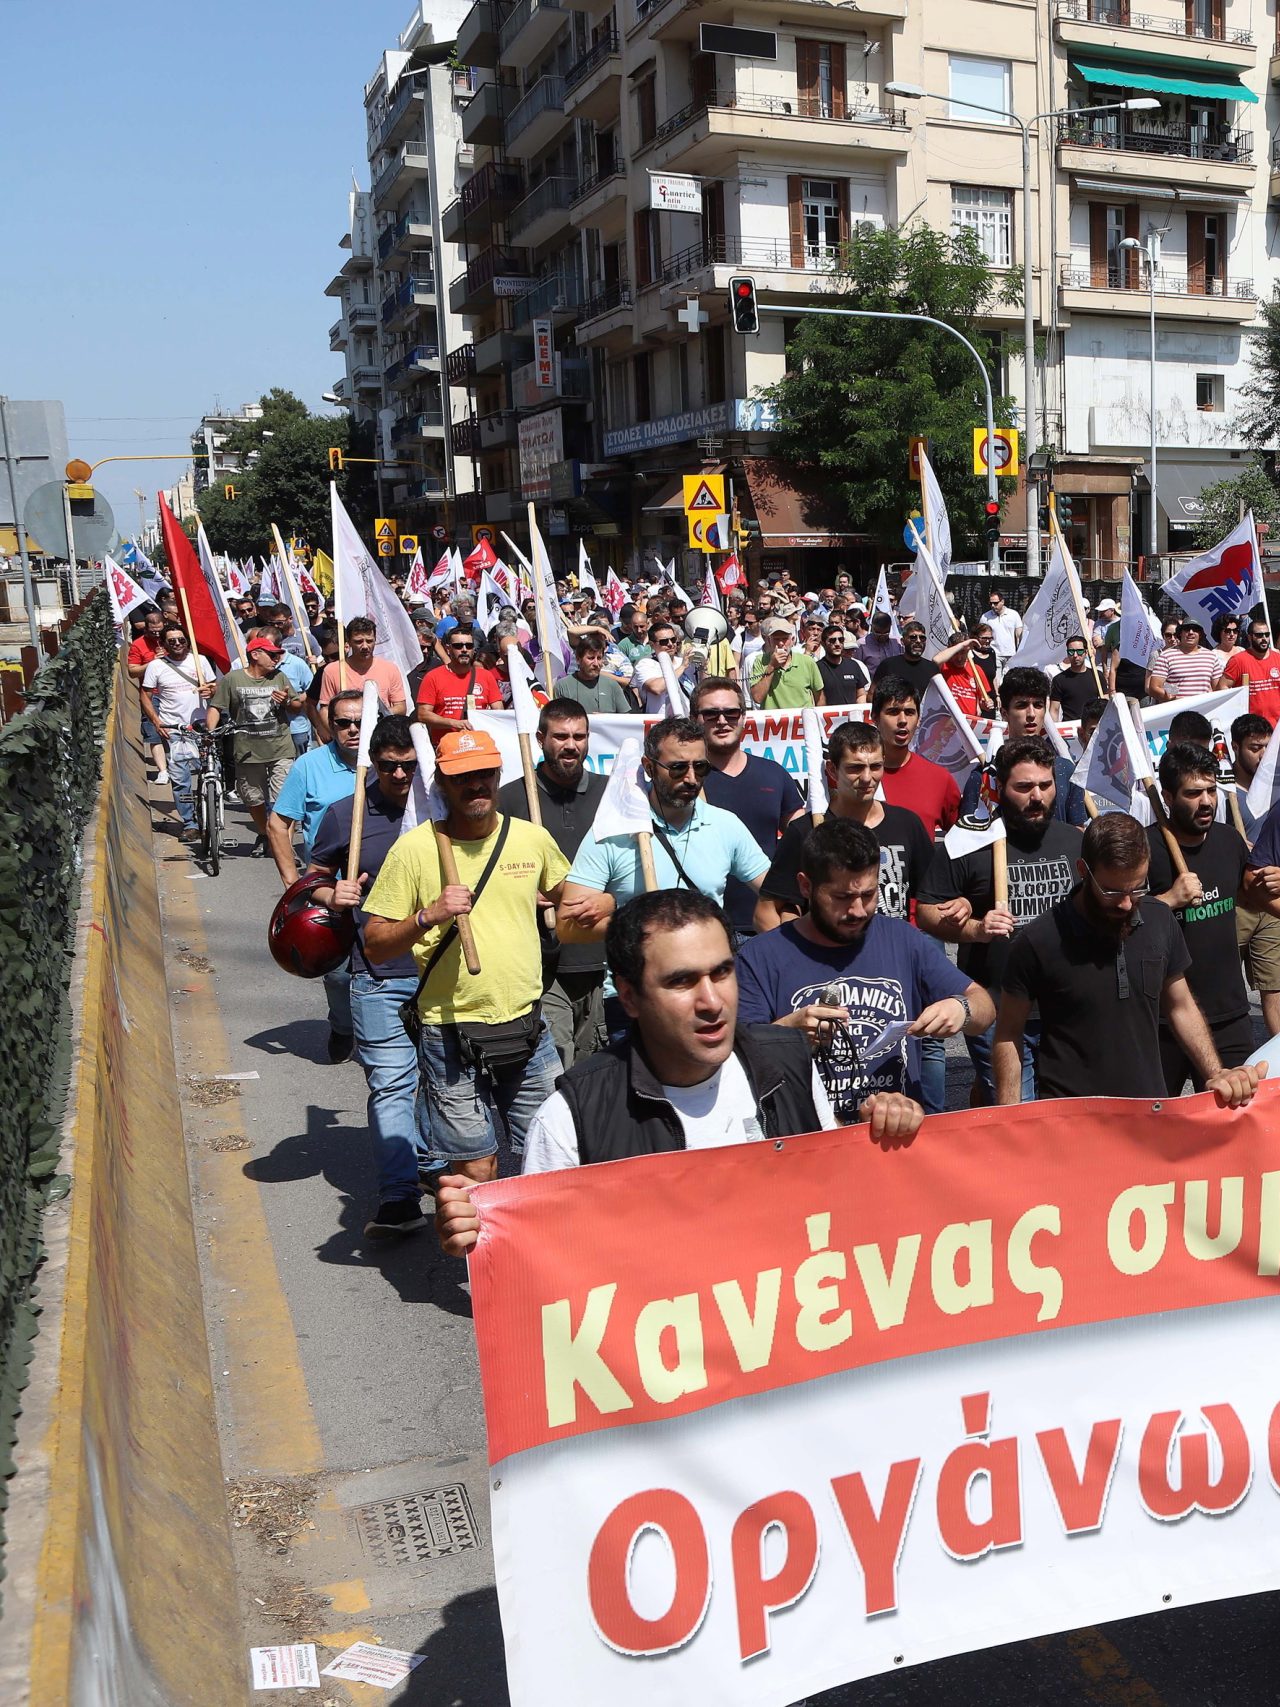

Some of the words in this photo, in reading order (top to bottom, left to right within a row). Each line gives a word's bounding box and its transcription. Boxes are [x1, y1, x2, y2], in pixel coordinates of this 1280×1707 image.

[608, 425, 642, 447] ΣΤΟΛΕΣ
[644, 405, 727, 439] ΠΑΡΑΔΟΣΙΑΚΕΣ
[1008, 862, 1070, 883] UMMER
[1185, 897, 1234, 923] MONSTER
[851, 1008, 876, 1017] TIME
[540, 1203, 1065, 1428] Κανένας
